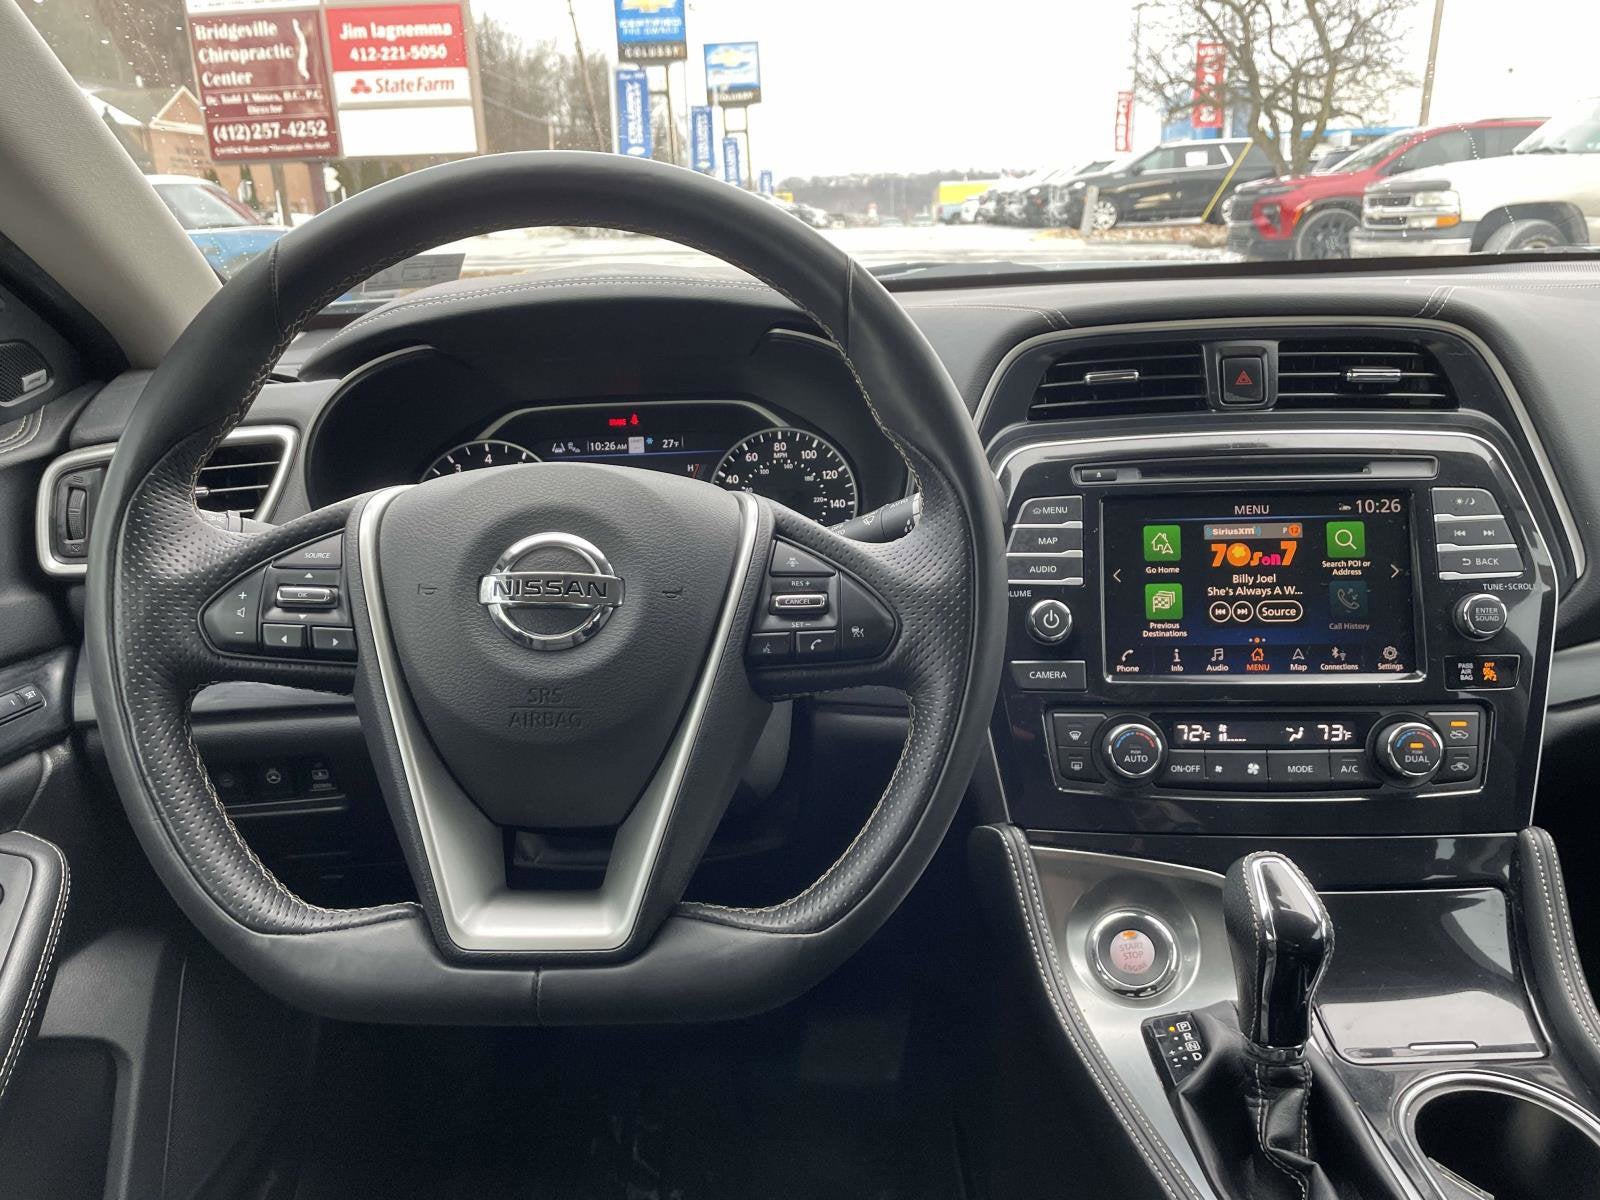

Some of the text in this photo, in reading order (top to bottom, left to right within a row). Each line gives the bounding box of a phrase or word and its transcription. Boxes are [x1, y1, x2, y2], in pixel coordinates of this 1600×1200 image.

[194, 20, 278, 42] Bridgeville
[339, 22, 368, 40] Jim
[198, 43, 295, 65] Chiropractic
[201, 71, 253, 88] Center
[590, 442, 616, 451] 10:26
[773, 442, 787, 451] 80
[484, 453, 492, 464] 4
[745, 452, 758, 462] 60
[801, 450, 817, 460] 100
[455, 463, 462, 473] 3
[726, 474, 739, 484] 40
[822, 470, 838, 480] 120
[830, 499, 846, 509] 140
[1355, 498, 1401, 513] 10:26
[1042, 506, 1068, 514] MENU
[1234, 504, 1270, 515] MENU
[1038, 537, 1058, 545] MAP
[1322, 560, 1347, 568] Search
[1348, 560, 1361, 568] POI
[1475, 558, 1500, 566] BACK
[1029, 565, 1057, 573] AUDIO
[1145, 565, 1180, 574] Go Home
[1332, 568, 1362, 576] Address
[1232, 573, 1277, 585] Billy Joel
[492, 578, 608, 599] NISSAN
[1207, 585, 1303, 597] She's Always A W...
[1008, 590, 1032, 598] LUME
[1261, 606, 1297, 617] Source
[1149, 622, 1180, 630] Previous
[1329, 623, 1370, 632] Call History
[1142, 630, 1188, 638] Destinations
[1116, 664, 1140, 673] Phone
[1171, 664, 1184, 672] Info
[1206, 663, 1229, 672] Audio
[1246, 663, 1270, 672] MENU
[1290, 663, 1307, 673] Map
[1320, 662, 1359, 671] Connections
[1378, 662, 1404, 672] Settings
[1029, 671, 1067, 679] CAMERA
[508, 711, 582, 729] AIRBAG
[1124, 754, 1149, 763] AUTO
[1404, 754, 1430, 763] DUAL
[1287, 765, 1313, 773] MODE
[1340, 764, 1359, 773] A/C
[1119, 943, 1143, 952] START
[1122, 951, 1144, 960] STOP
[1183, 1032, 1193, 1041] R
[1192, 1052, 1202, 1061] D
